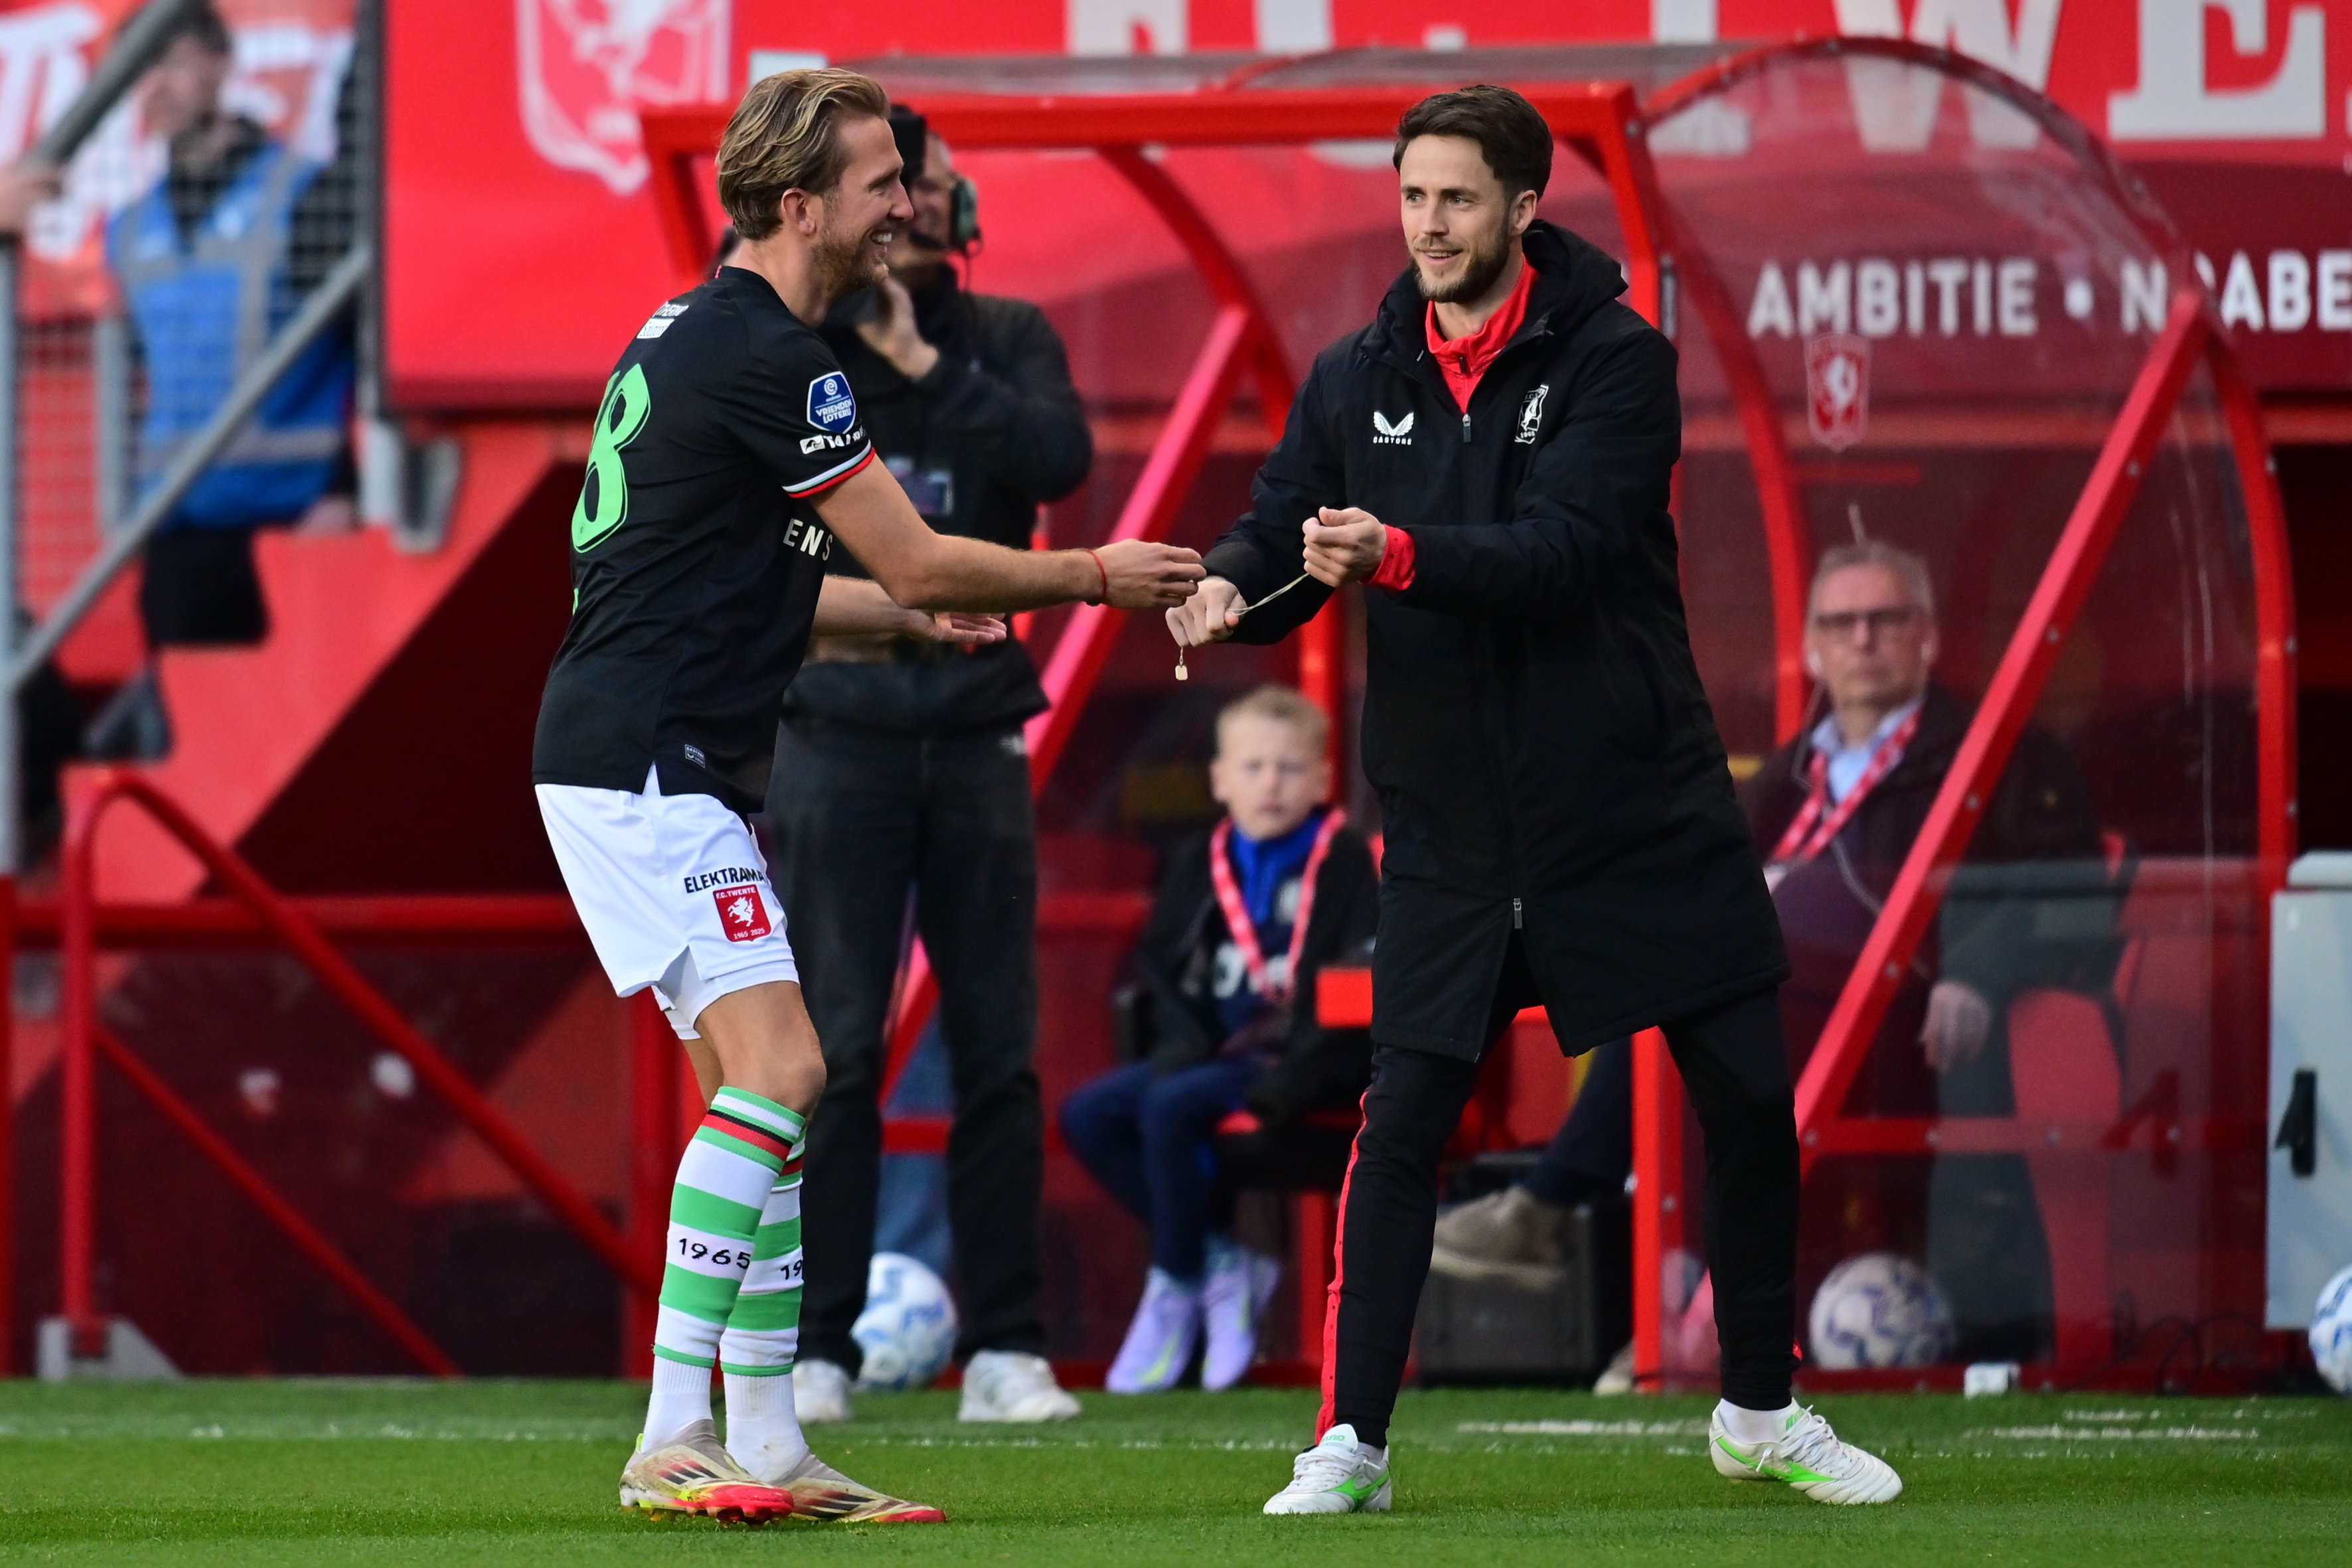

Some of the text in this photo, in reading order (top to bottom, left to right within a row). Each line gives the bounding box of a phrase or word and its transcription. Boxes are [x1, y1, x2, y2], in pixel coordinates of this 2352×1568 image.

[1747, 260, 2039, 337] AMBITIE
[816, 399, 852, 417] VRIENDEN
[1372, 436, 1412, 445] CASTORE
[572, 363, 651, 554] 8
[684, 867, 769, 894] ELEKTRAMA
[727, 886, 756, 897] TWENTE
[733, 931, 749, 940] 1965
[678, 1238, 751, 1269] 1965
[780, 1259, 803, 1280] 19
